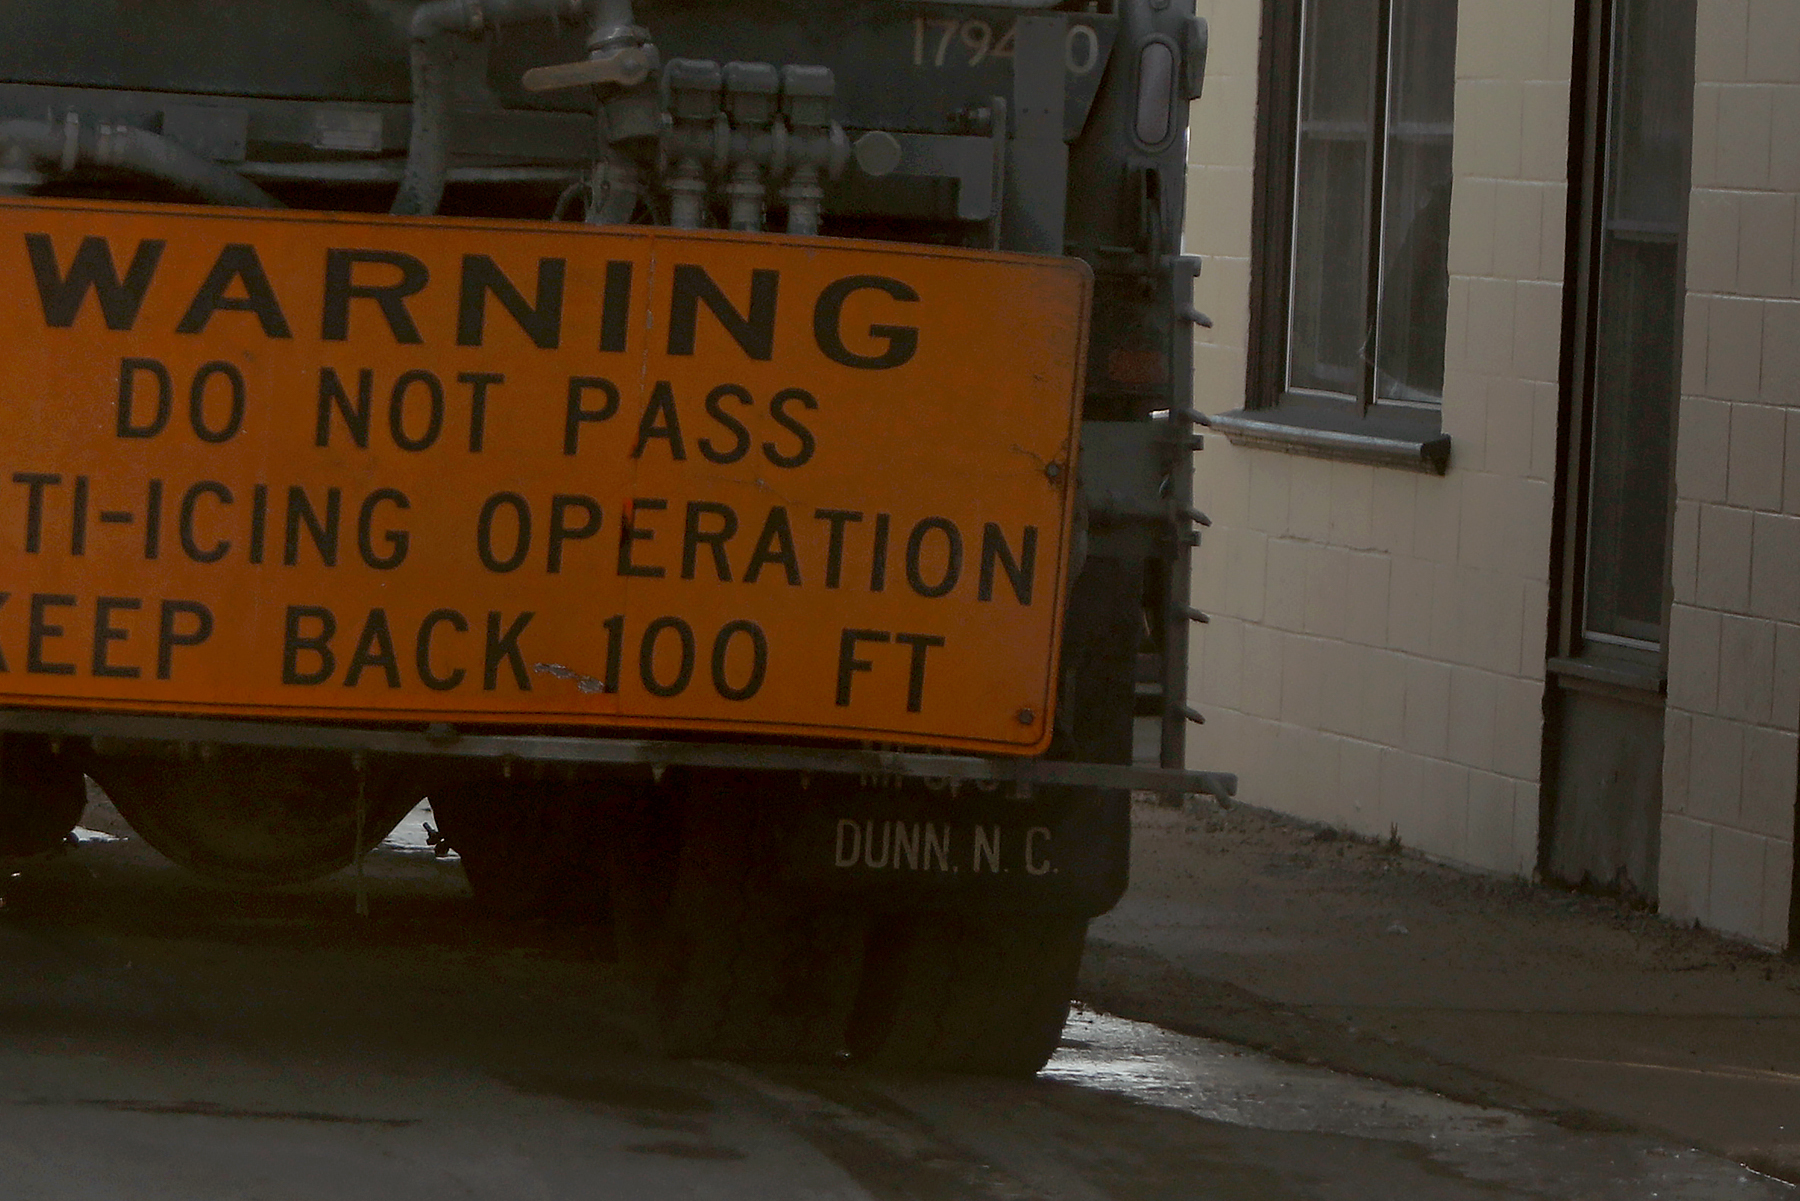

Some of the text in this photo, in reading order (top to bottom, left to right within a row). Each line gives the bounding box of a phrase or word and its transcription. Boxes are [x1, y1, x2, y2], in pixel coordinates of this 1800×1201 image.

[24, 232, 920, 371] WARNING
[115, 357, 818, 469] DO NOT PASS
[477, 491, 1038, 606] OPERATION
[282, 605, 535, 695] BACK
[596, 615, 768, 702] 100
[835, 628, 946, 713] FT
